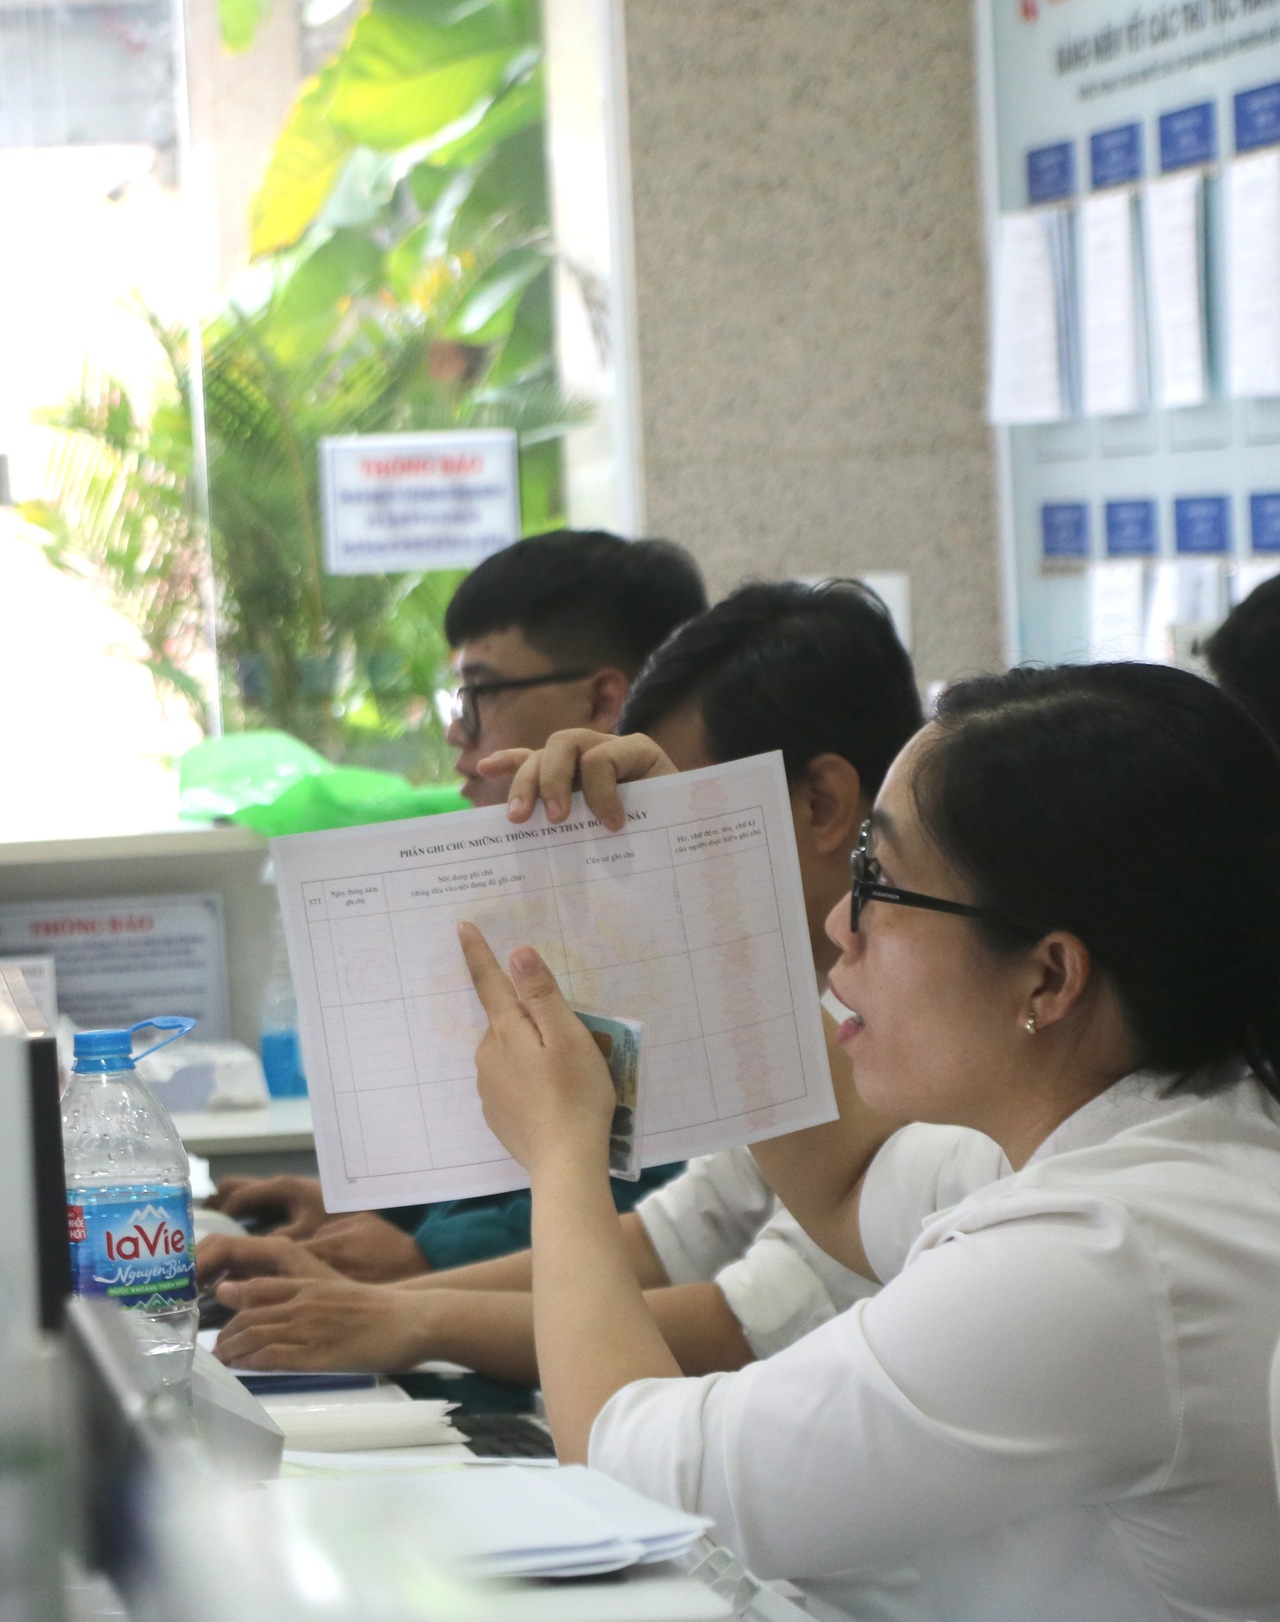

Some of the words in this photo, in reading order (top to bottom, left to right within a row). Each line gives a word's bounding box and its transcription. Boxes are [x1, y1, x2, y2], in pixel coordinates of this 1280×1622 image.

[426, 844, 445, 855] GHI
[446, 839, 467, 851] CHÚ
[468, 835, 503, 849] NHỮNG
[505, 829, 539, 842] THÔNG
[541, 826, 558, 836] TIN
[560, 820, 585, 833] THAY
[627, 810, 648, 822] NÀY
[611, 853, 622, 863] ghi
[309, 897, 322, 906] STT
[29, 917, 97, 938] THÔNG
[109, 913, 155, 934] BÁO
[106, 1221, 185, 1261] laVie
